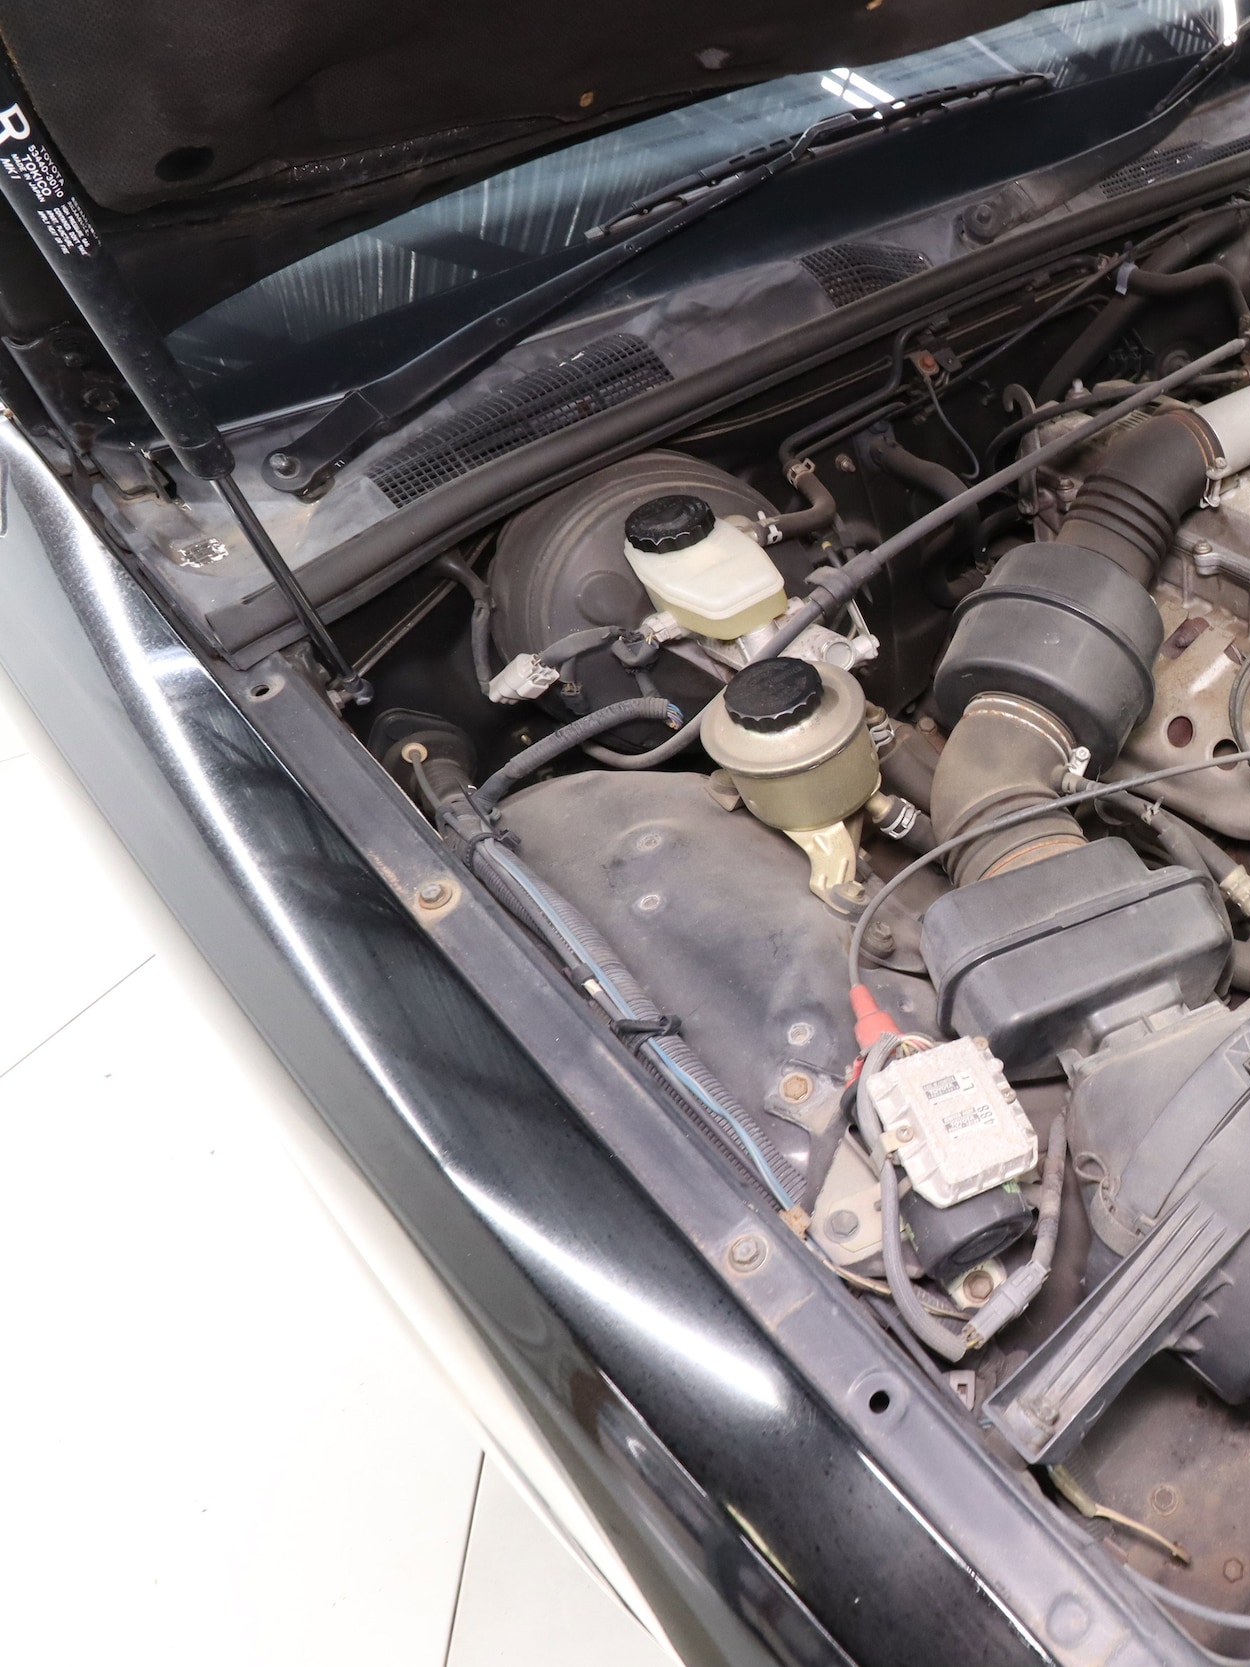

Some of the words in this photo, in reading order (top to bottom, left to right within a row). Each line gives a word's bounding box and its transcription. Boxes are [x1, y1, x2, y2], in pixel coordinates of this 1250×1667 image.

[0, 103, 31, 145] R
[11, 153, 27, 172] MADE
[23, 173, 32, 181] IN
[28, 181, 47, 203] JAPAN
[21, 154, 52, 196] TOKICO
[28, 144, 64, 198] 53440-30110
[40, 145, 65, 187] TOYOTA
